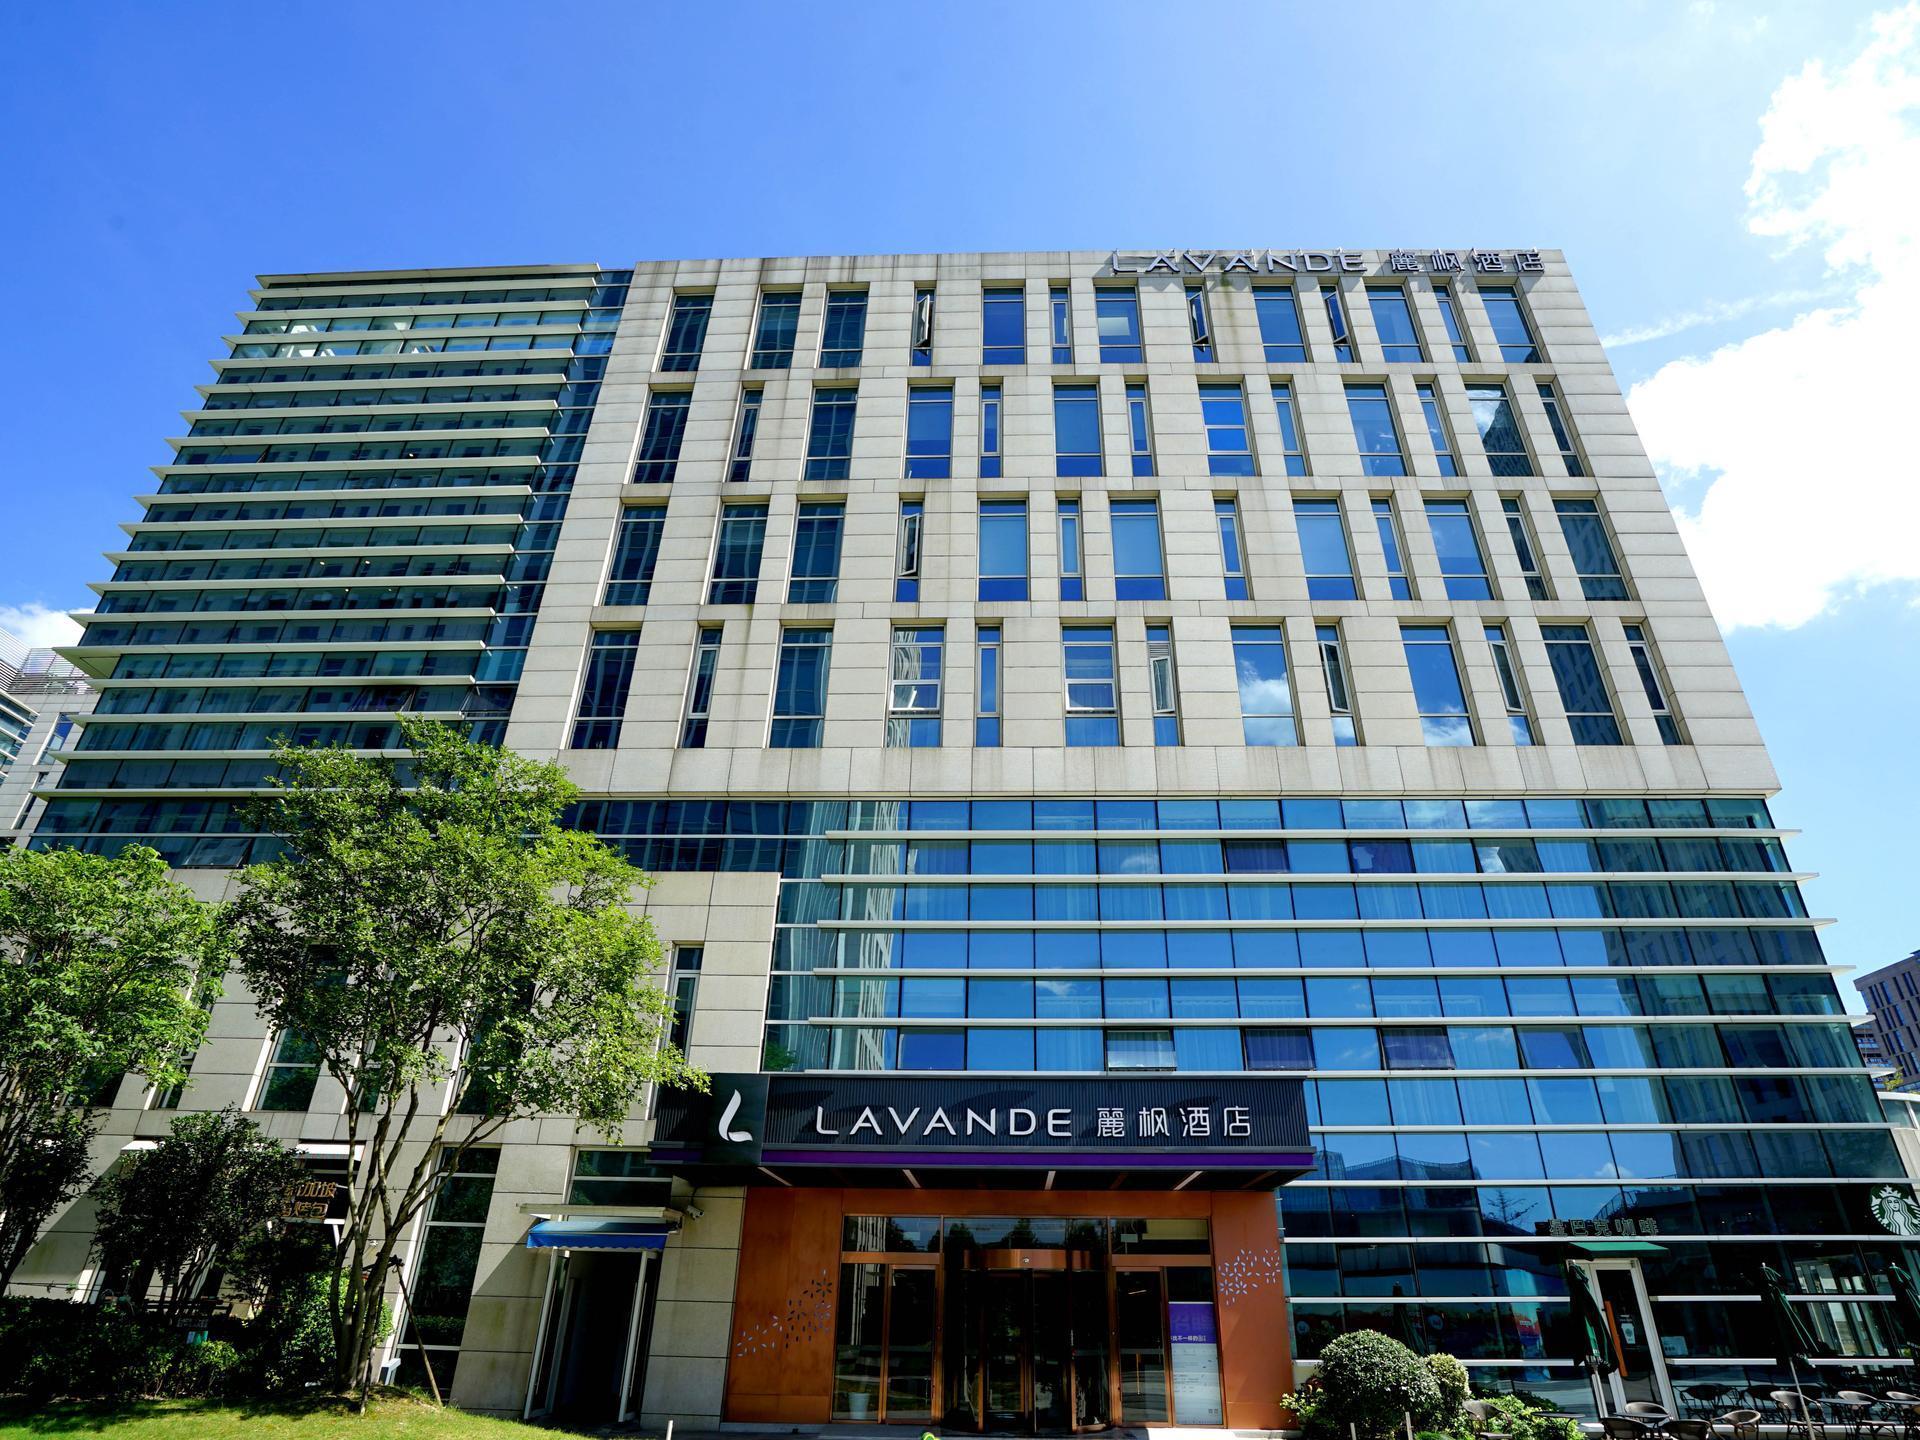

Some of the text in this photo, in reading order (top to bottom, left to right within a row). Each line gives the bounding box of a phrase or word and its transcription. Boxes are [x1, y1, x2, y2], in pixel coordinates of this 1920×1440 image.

[1112, 252, 1367, 273] LAVANDE
[816, 1105, 1072, 1137] LAVANDE
[1550, 1217, 1660, 1236] 星巴克咖啡
